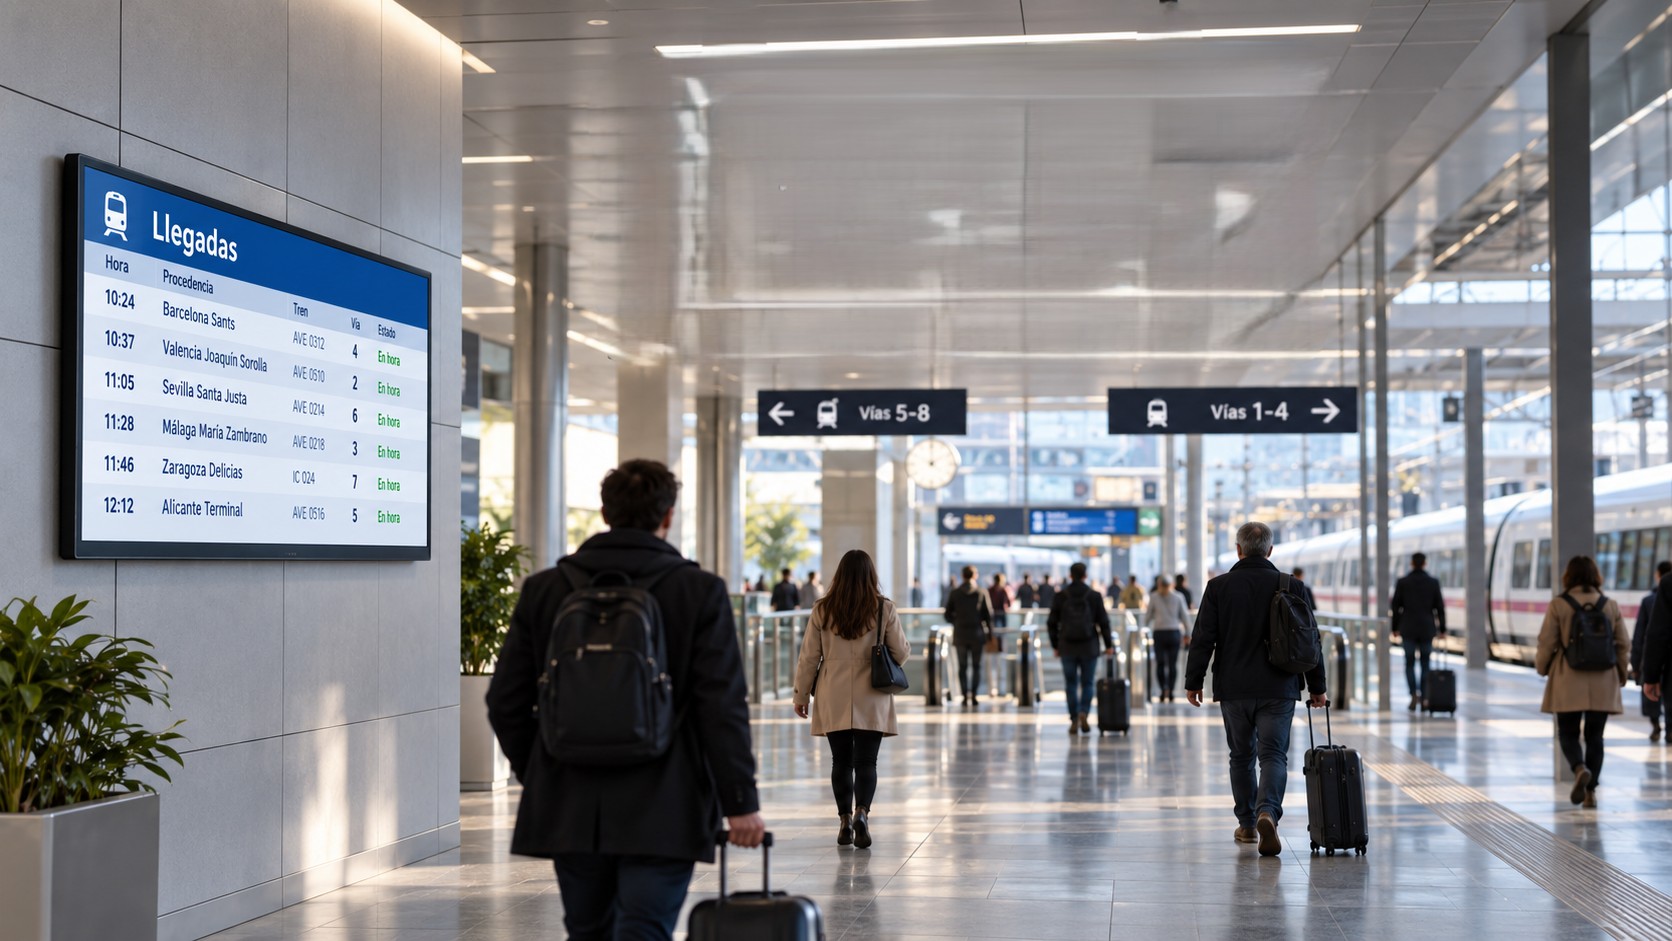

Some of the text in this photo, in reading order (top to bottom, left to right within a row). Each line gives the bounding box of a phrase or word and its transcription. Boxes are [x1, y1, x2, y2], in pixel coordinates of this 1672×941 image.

[153, 210, 238, 262] Llegadas
[106, 254, 128, 273] Hora
[163, 269, 214, 294] Procedencia
[293, 302, 308, 317] Tren
[378, 324, 396, 339] Estado
[106, 289, 135, 309] 10:24
[163, 301, 208, 325] Barcelona
[212, 312, 235, 330] Sants
[293, 331, 307, 346] AVE
[353, 344, 358, 358] 4
[378, 350, 385, 363] En
[387, 352, 400, 366] hora
[105, 330, 134, 349] 10:37
[163, 339, 201, 360] Valencia
[205, 348, 237, 368] Joaquín
[240, 354, 267, 372] Sorolla
[293, 365, 307, 379] AVE
[353, 376, 358, 390] 2
[378, 382, 385, 394] En
[387, 383, 400, 397] hora
[105, 372, 134, 390] 11:05
[163, 379, 193, 397] Sevilla
[197, 384, 221, 401] Santa
[224, 389, 246, 405] Justa
[293, 400, 307, 414] AVE
[353, 408, 358, 423] 6
[378, 413, 385, 426] En
[387, 415, 400, 428] hora
[858, 404, 930, 422] Vías 5-8
[1210, 402, 1289, 421] Vías 1-4
[105, 413, 134, 431] 11:28
[163, 419, 196, 440] Málaga
[200, 423, 223, 439] María
[226, 426, 267, 444] Zambrano
[293, 435, 307, 449] AVE
[353, 441, 358, 456] 3
[378, 445, 385, 457] En
[387, 447, 400, 459] hora
[105, 455, 400, 491] 11:46 Zaragoza Delicias IC 024 7 En hora
[104, 497, 133, 513] 12:12
[162, 499, 201, 515] Alicante
[204, 501, 242, 516] Terminal
[293, 506, 306, 519] AVE
[353, 508, 358, 522] 5
[378, 510, 385, 523] En
[387, 511, 400, 523] hora
